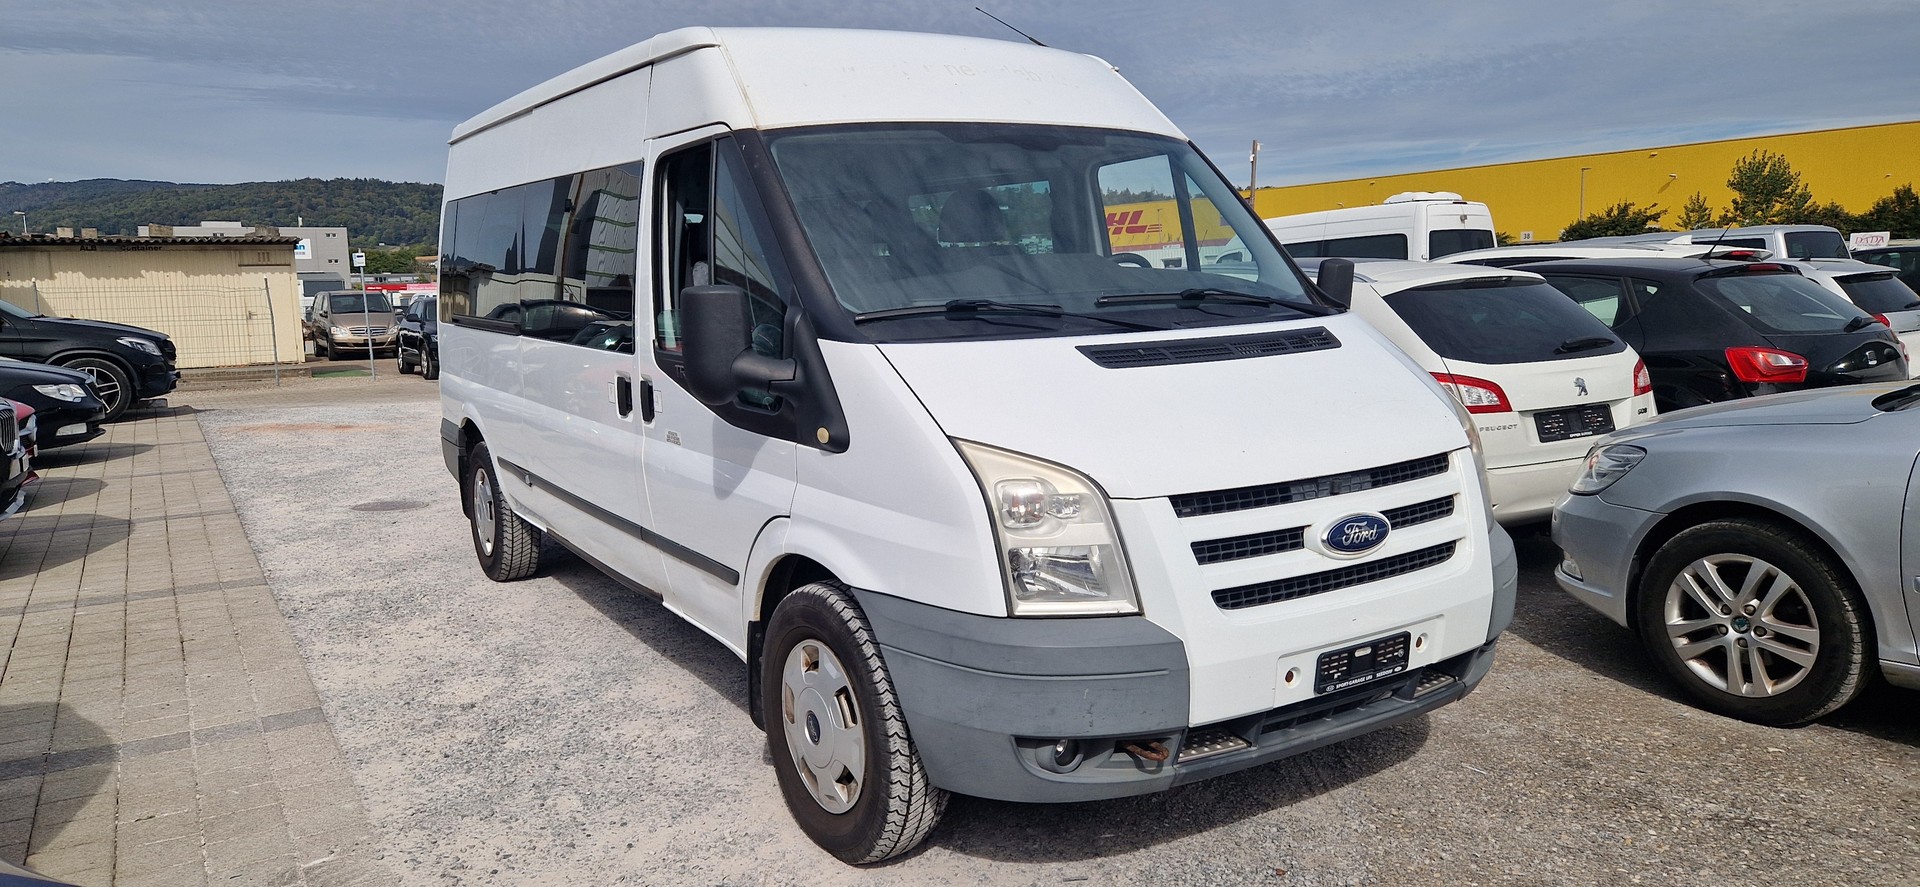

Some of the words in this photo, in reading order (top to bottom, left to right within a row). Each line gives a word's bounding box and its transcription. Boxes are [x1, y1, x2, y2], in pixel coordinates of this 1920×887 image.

[1106, 210, 1147, 235] HL
[674, 364, 687, 379] TR
[1479, 423, 1518, 433] PEUGEOT
[1342, 521, 1378, 546] Ford
